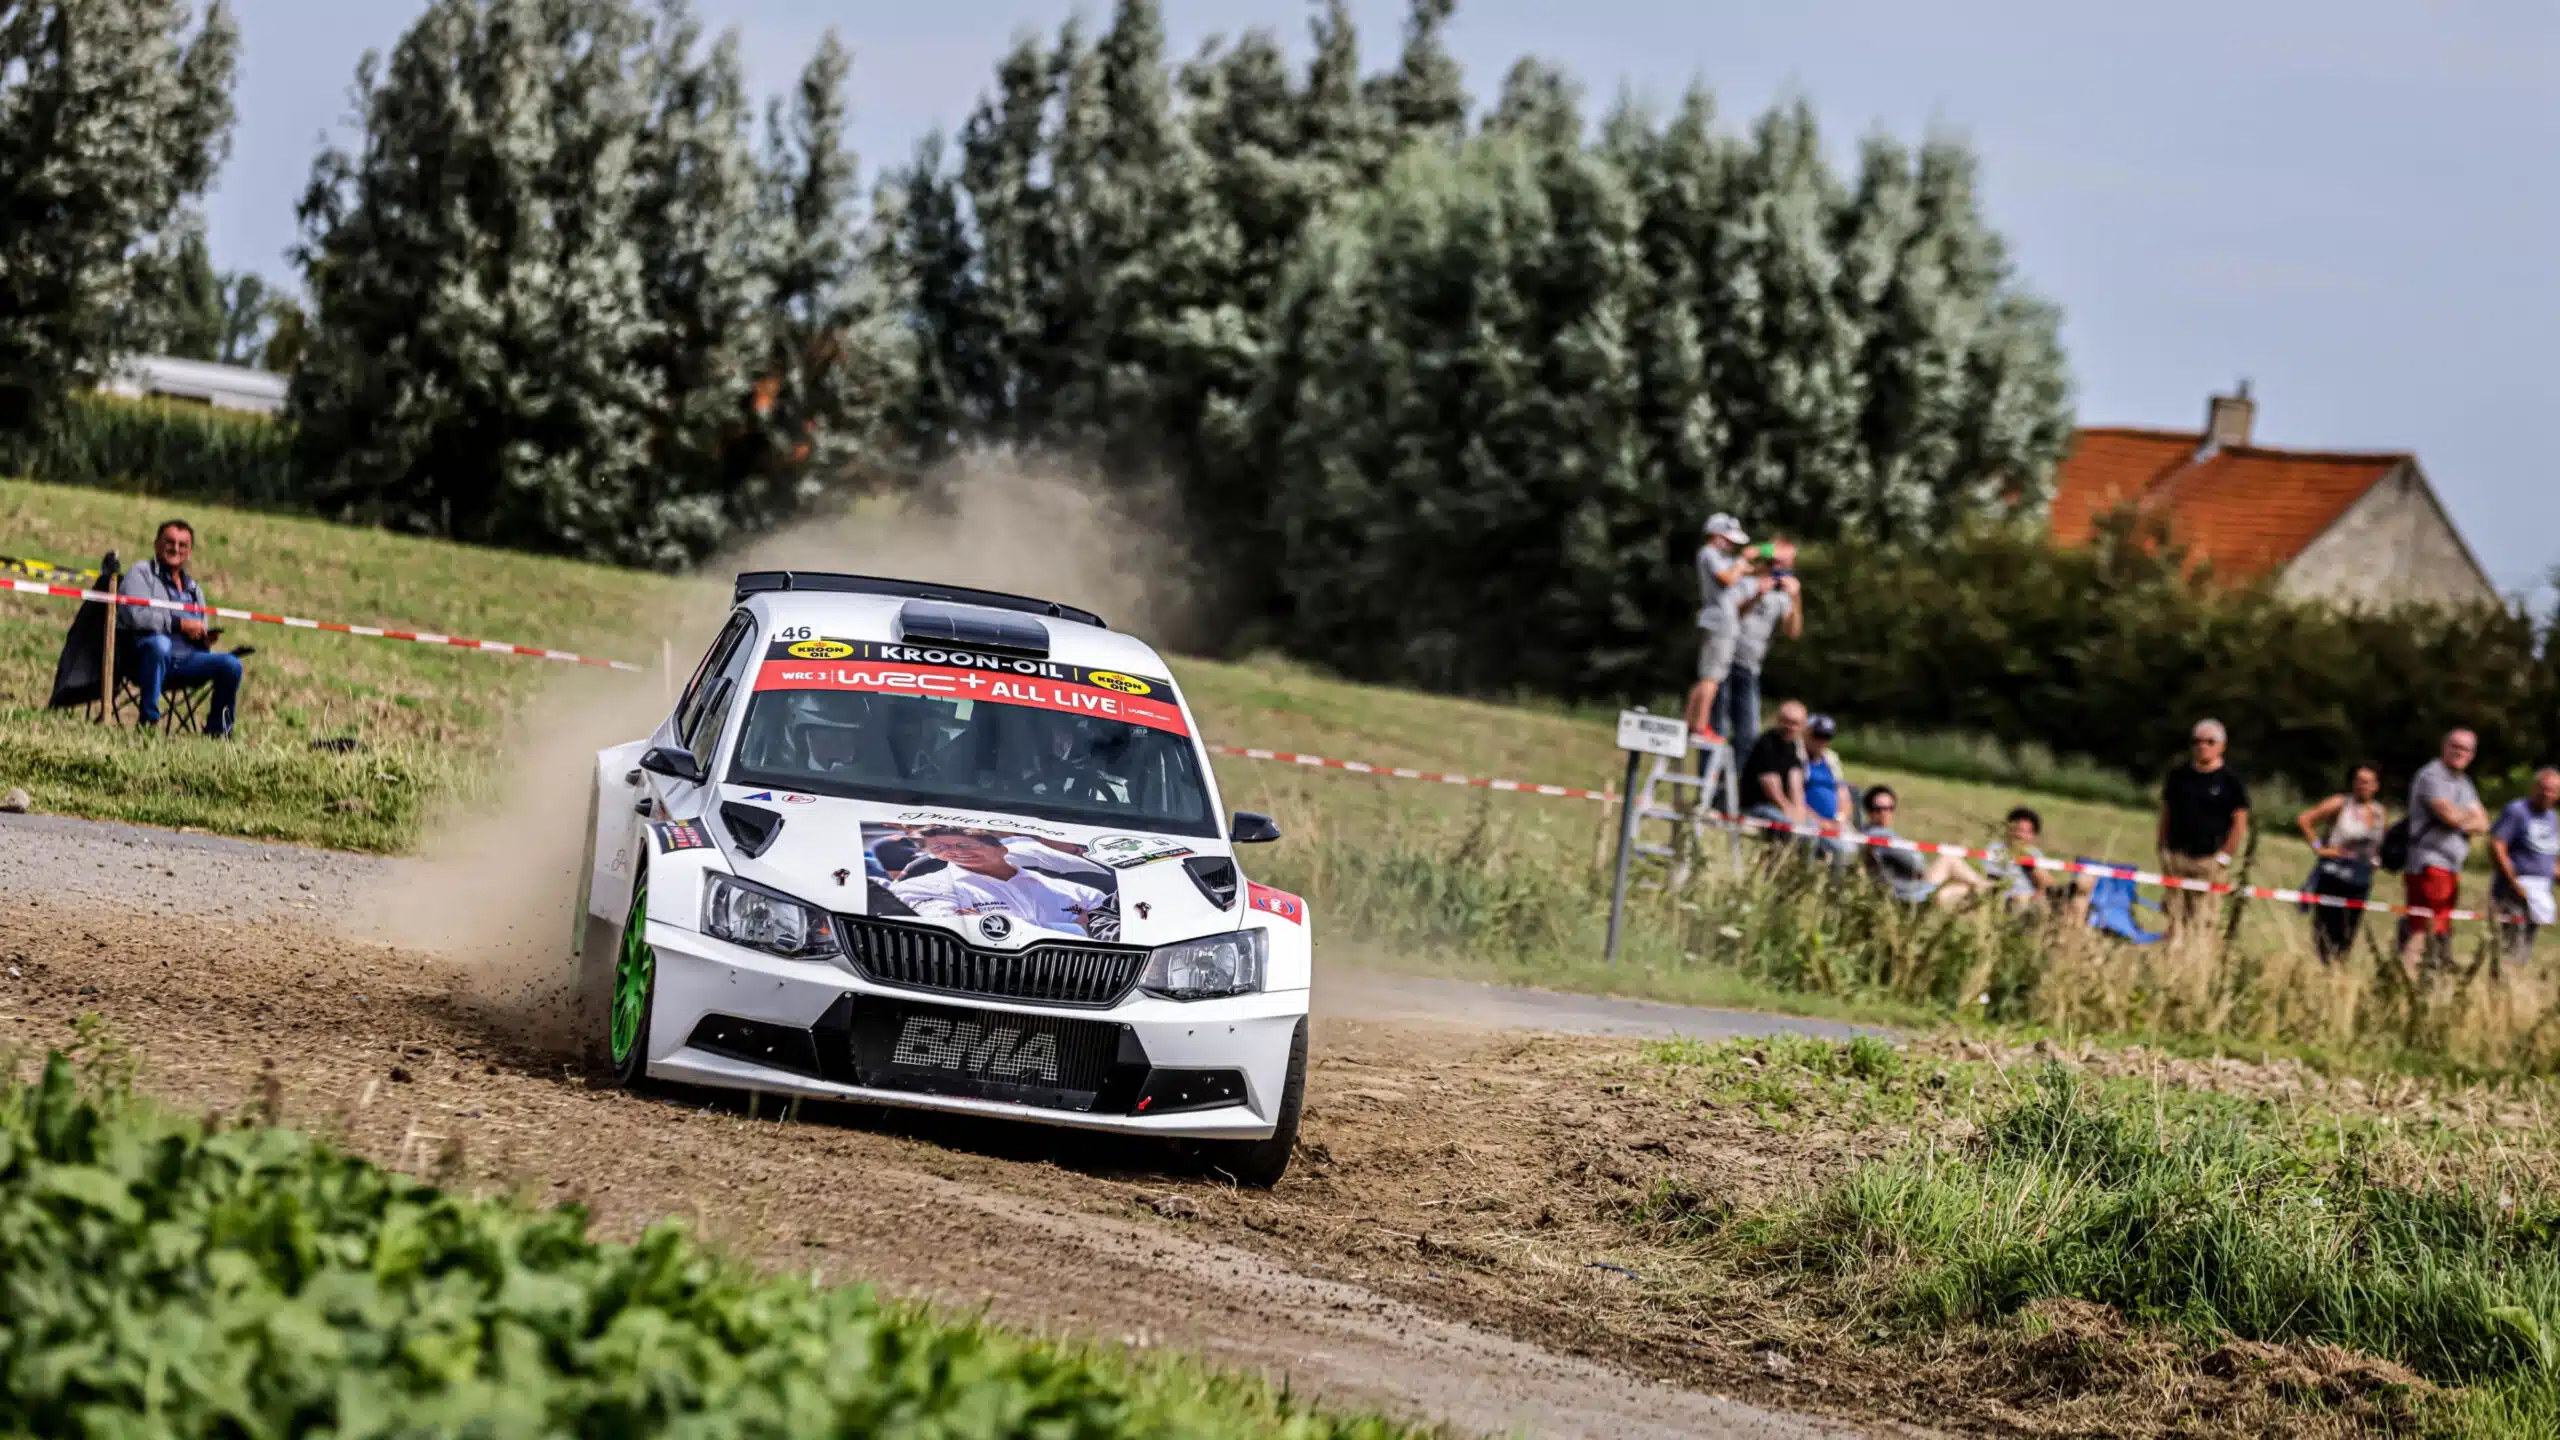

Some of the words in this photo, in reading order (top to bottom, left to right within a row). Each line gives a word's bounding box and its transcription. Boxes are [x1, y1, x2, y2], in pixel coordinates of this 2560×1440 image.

[781, 626, 812, 640] 46
[881, 645, 1064, 679] KROON-OIL
[782, 671, 813, 680] WRC
[817, 672, 826, 680] 3
[1097, 675, 1142, 690] KROON
[1109, 683, 1130, 692] OIL
[991, 682, 1046, 703] ALL
[1054, 689, 1118, 714] LIVE
[891, 1015, 1058, 1082] BMA
